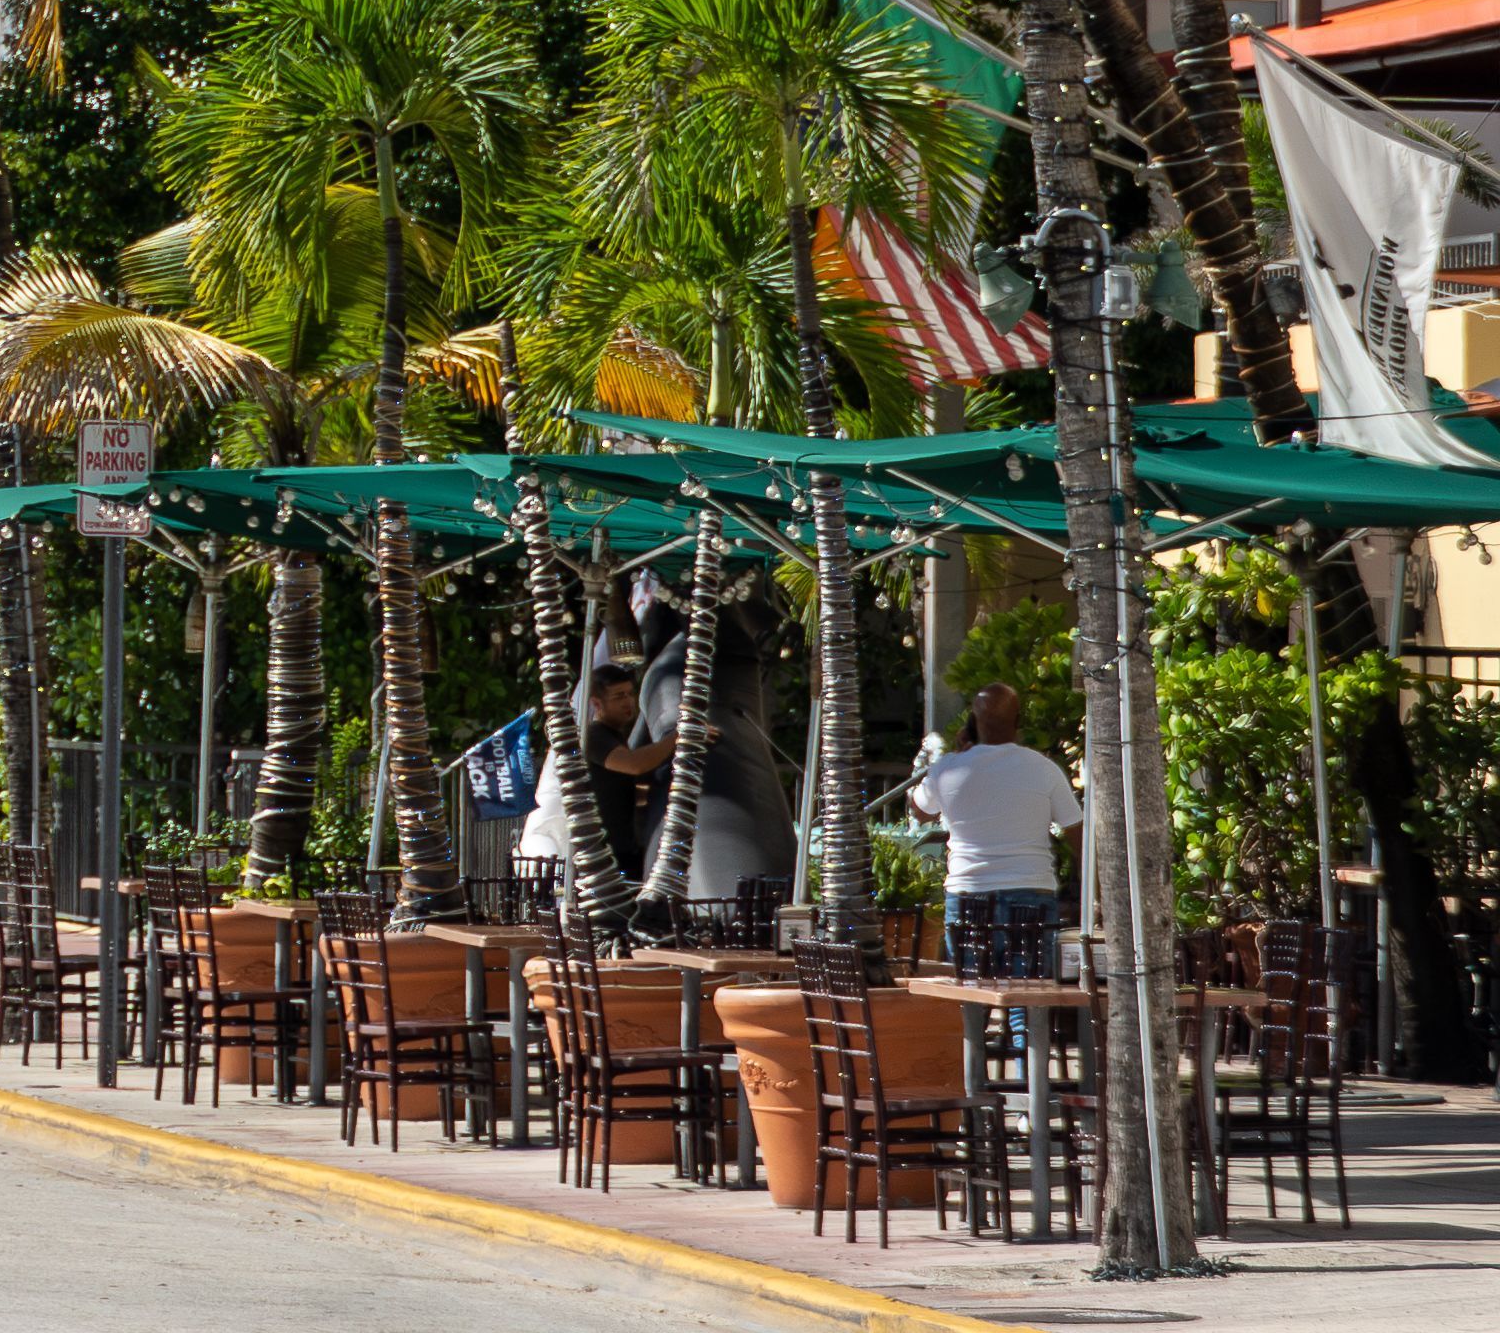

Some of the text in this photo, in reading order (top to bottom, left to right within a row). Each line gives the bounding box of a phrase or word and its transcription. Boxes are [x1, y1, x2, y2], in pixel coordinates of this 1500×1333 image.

[102, 428, 130, 448] NO
[86, 452, 146, 472] PARKING
[466, 755, 491, 800] ACK
[491, 735, 514, 802] OOTBALL
